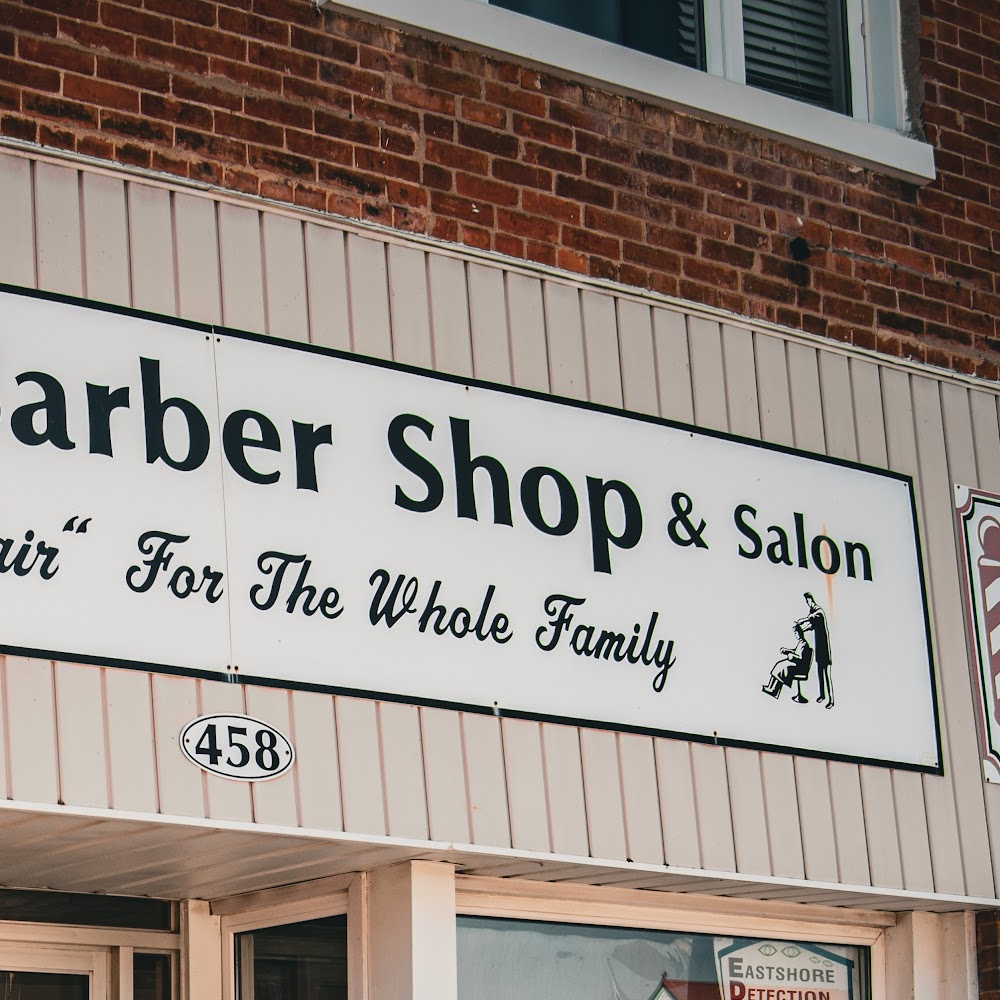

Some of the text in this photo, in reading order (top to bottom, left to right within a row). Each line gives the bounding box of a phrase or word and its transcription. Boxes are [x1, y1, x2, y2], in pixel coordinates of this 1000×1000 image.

[387, 413, 643, 575] Shop
[667, 491, 709, 550] &
[733, 504, 875, 583] Salon
[125, 530, 224, 604] For
[249, 550, 344, 620] The
[368, 568, 514, 644] Whole
[535, 593, 677, 693] Family
[195, 723, 280, 771] 458
[728, 957, 835, 983] EASTSHORE
